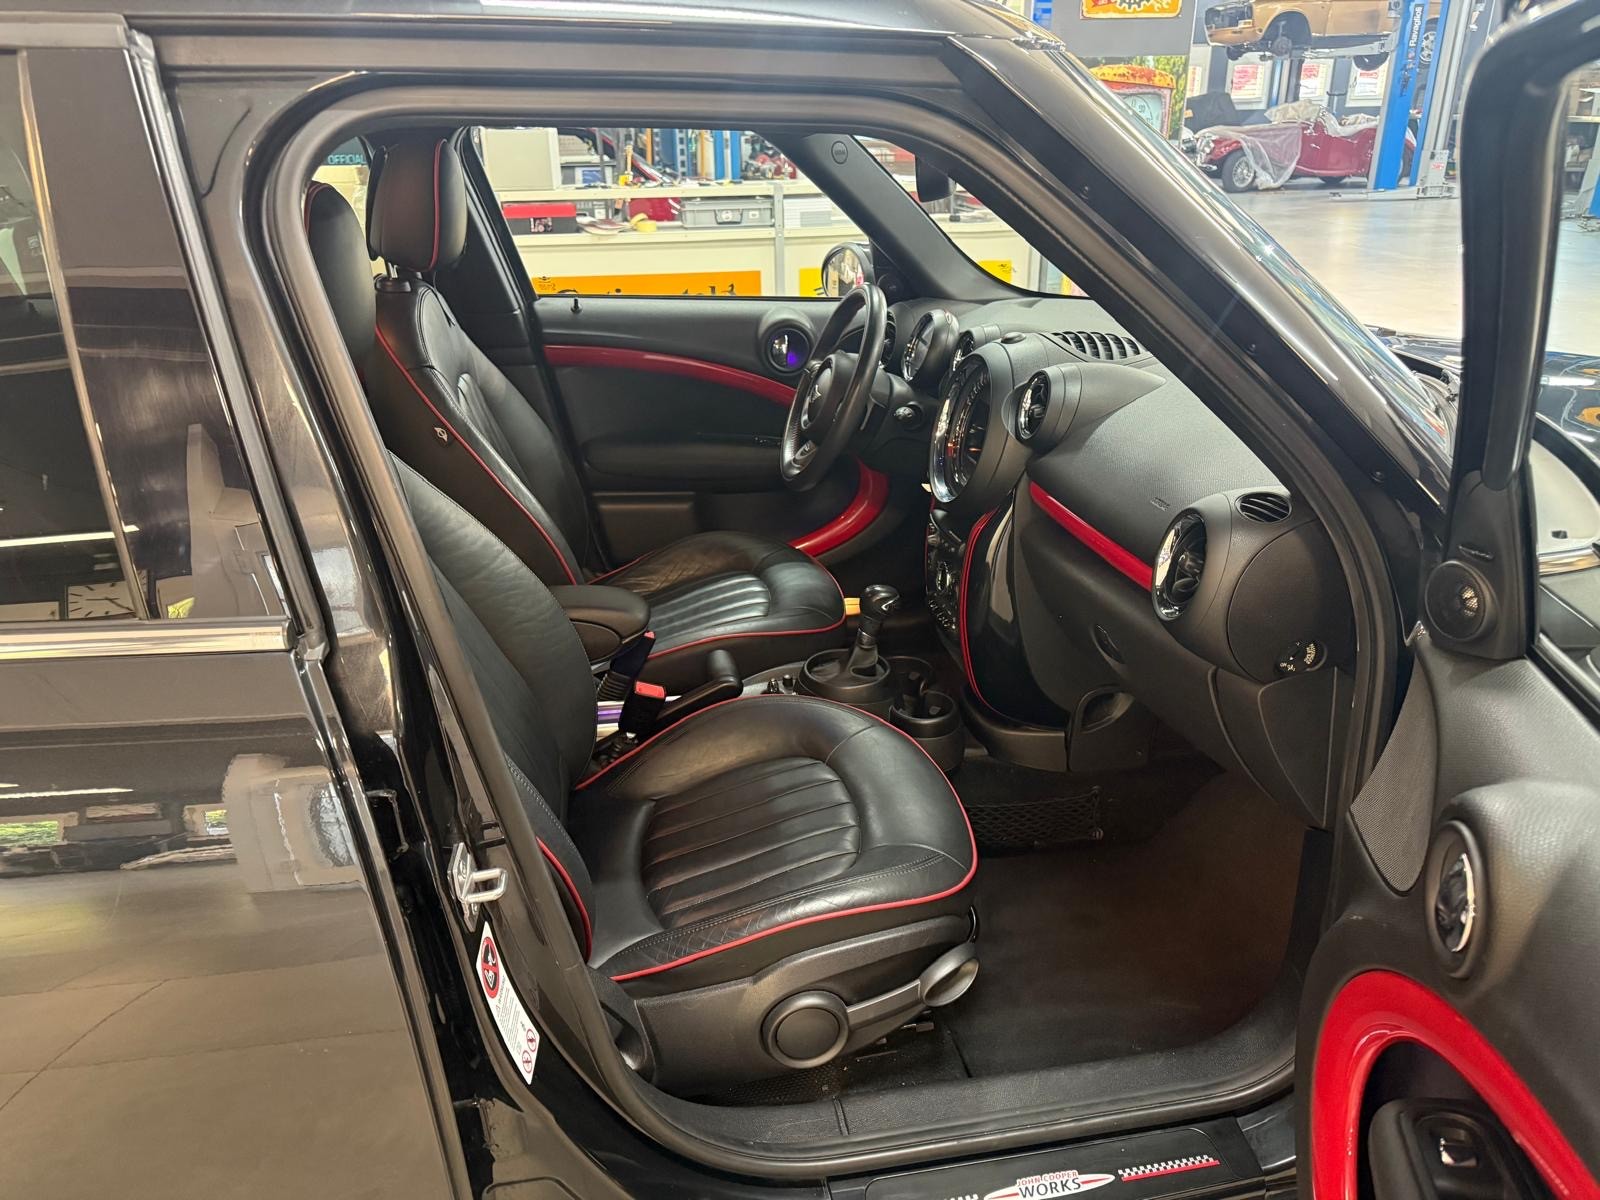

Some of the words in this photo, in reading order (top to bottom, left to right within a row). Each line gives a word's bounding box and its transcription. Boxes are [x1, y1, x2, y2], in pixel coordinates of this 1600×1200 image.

[327, 154, 367, 165] OFFICIAL
[1017, 1177, 1040, 1187] JOHN
[1041, 1171, 1079, 1182] COOPER
[1019, 1177, 1082, 1198] WORKS
